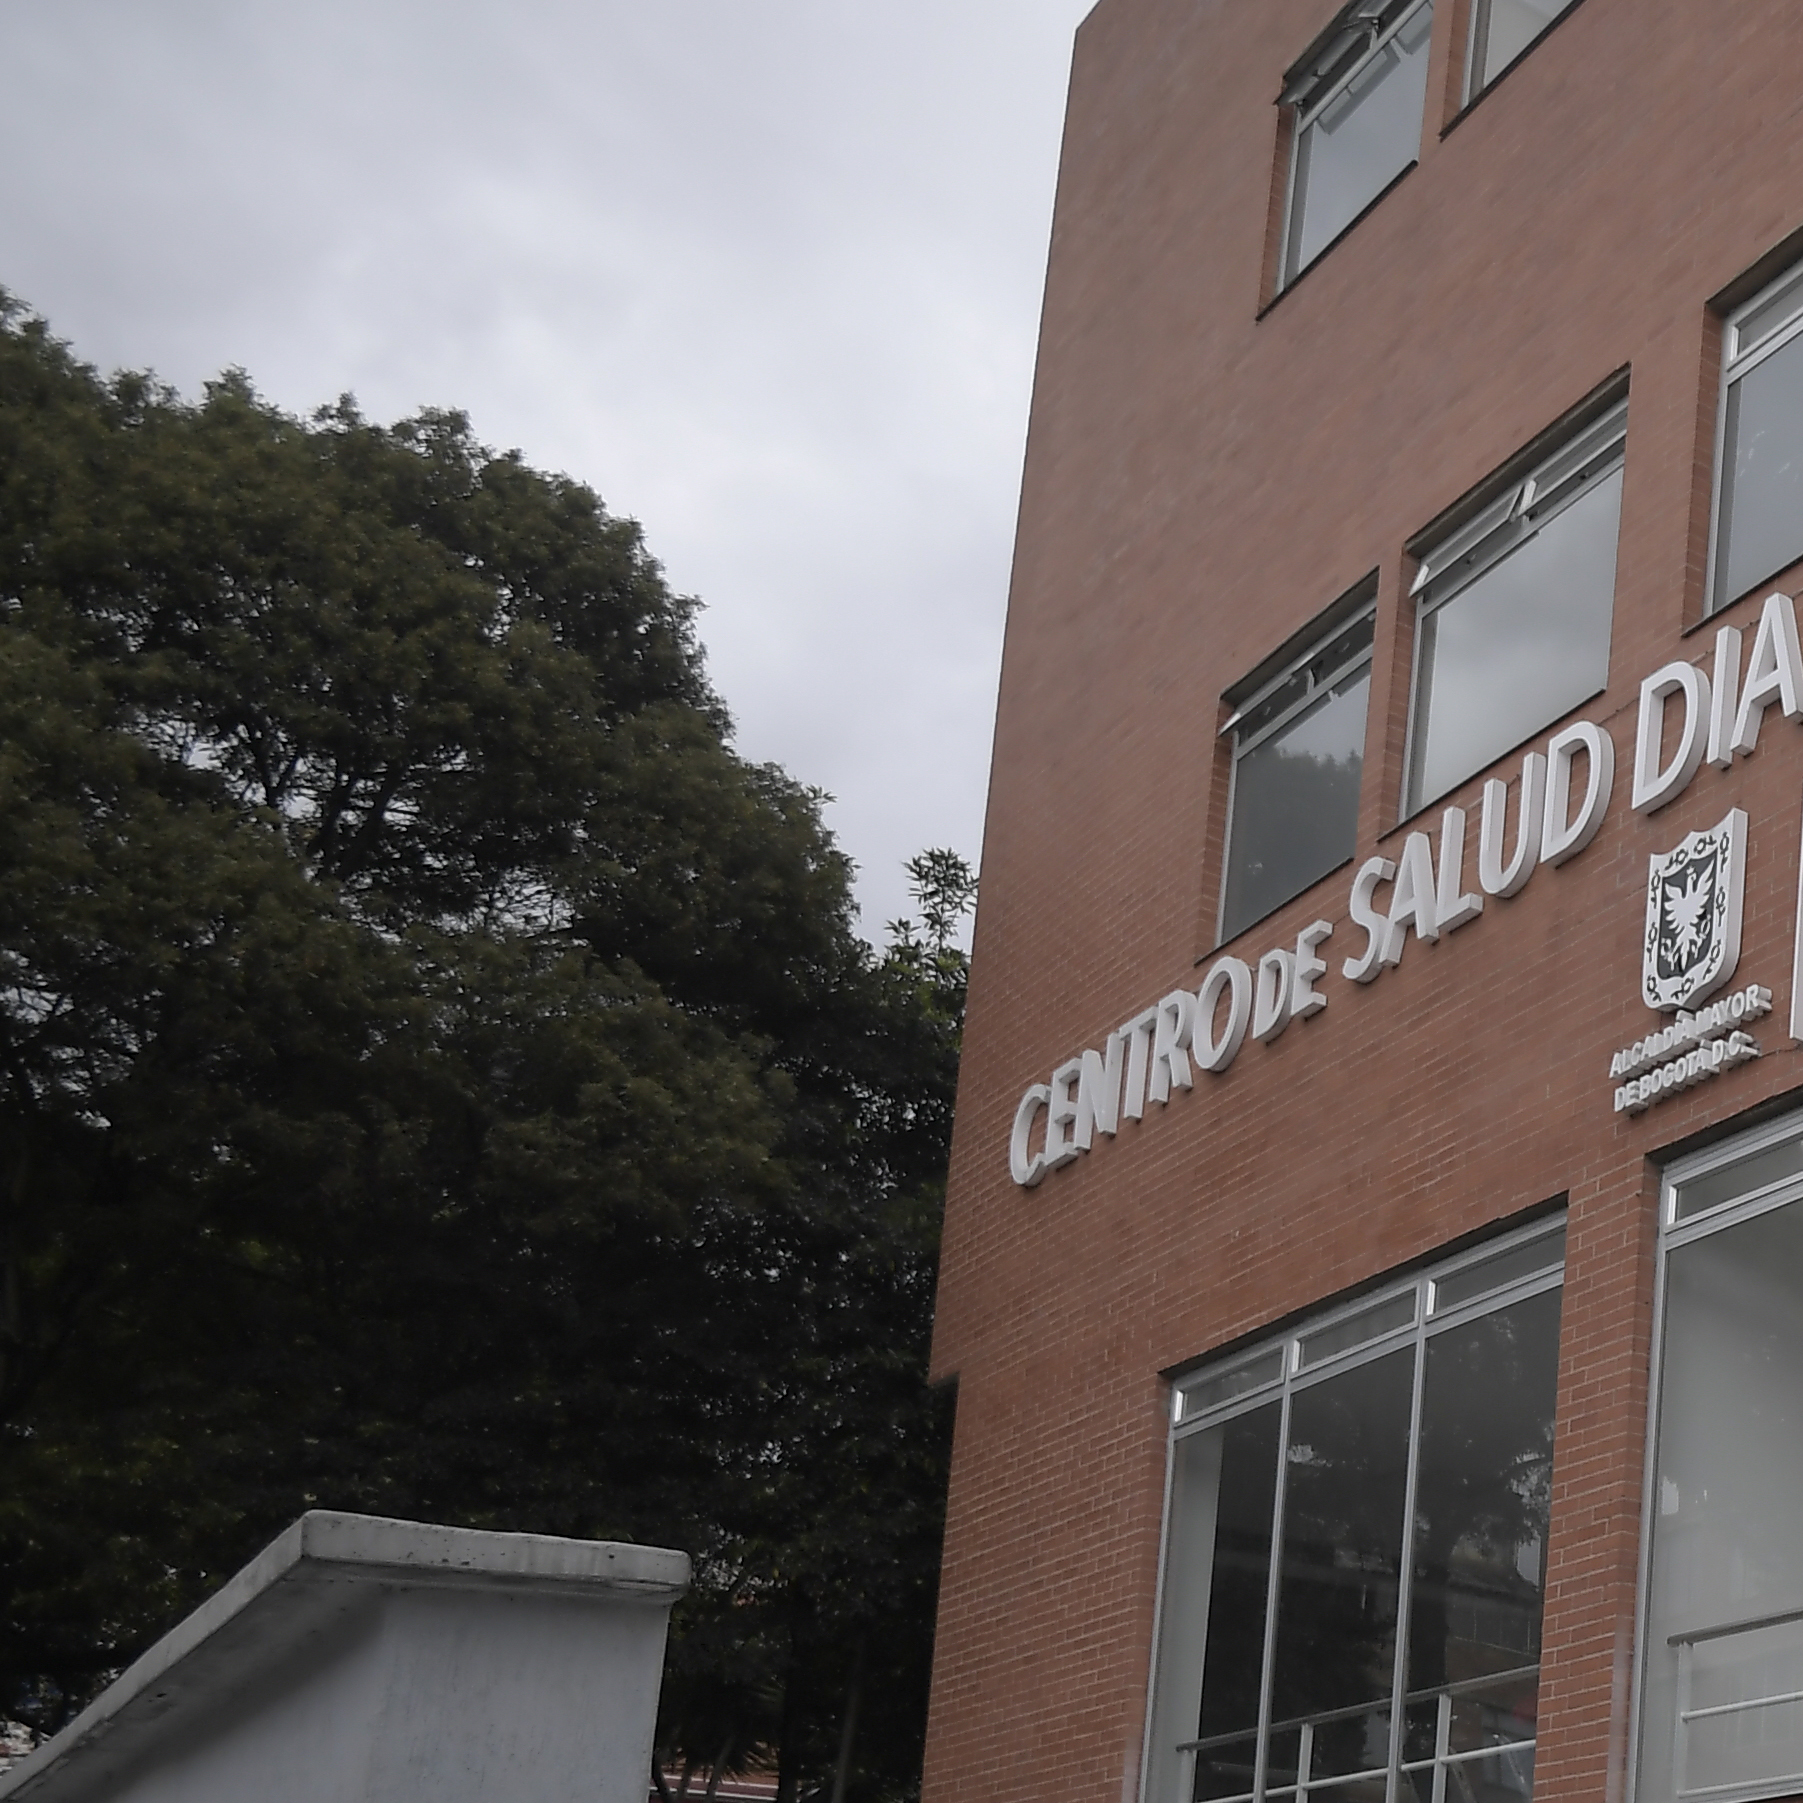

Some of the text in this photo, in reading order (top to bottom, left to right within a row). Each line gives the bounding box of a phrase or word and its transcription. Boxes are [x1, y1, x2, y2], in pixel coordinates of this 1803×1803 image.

[1008, 955, 1254, 1187] CENTRO
[1252, 919, 1333, 1043] DE
[1341, 719, 1614, 983] SALUD
[1695, 984, 1773, 1037] MAYOR
[1614, 1080, 1648, 1115] DE
